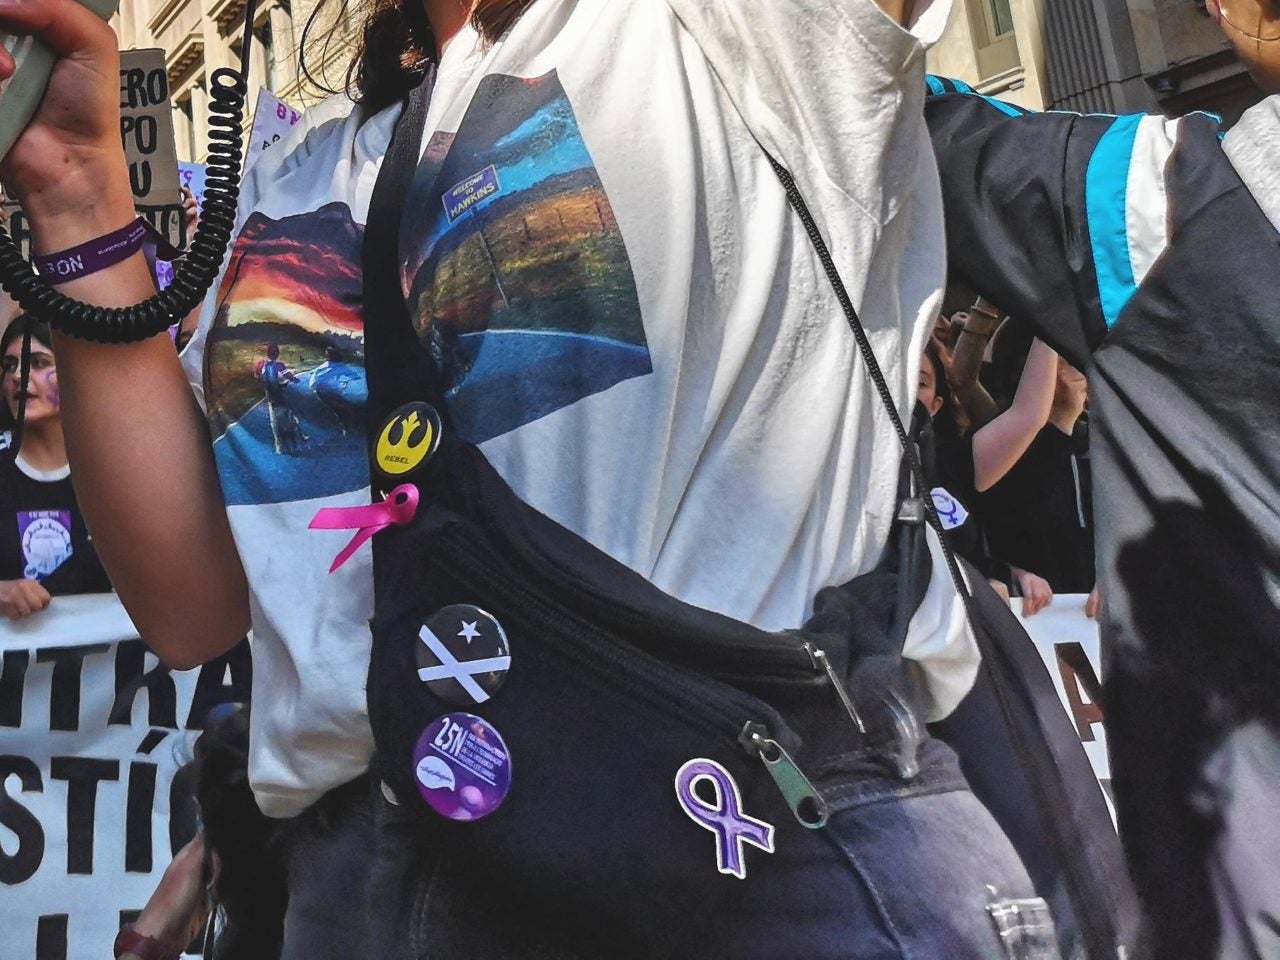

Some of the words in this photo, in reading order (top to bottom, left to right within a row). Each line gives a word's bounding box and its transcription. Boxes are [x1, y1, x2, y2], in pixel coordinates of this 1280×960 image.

[450, 182, 495, 218] HAWKINS
[452, 173, 485, 197] WELCOME
[383, 454, 409, 465] REBEL
[434, 717, 469, 757] 25N
